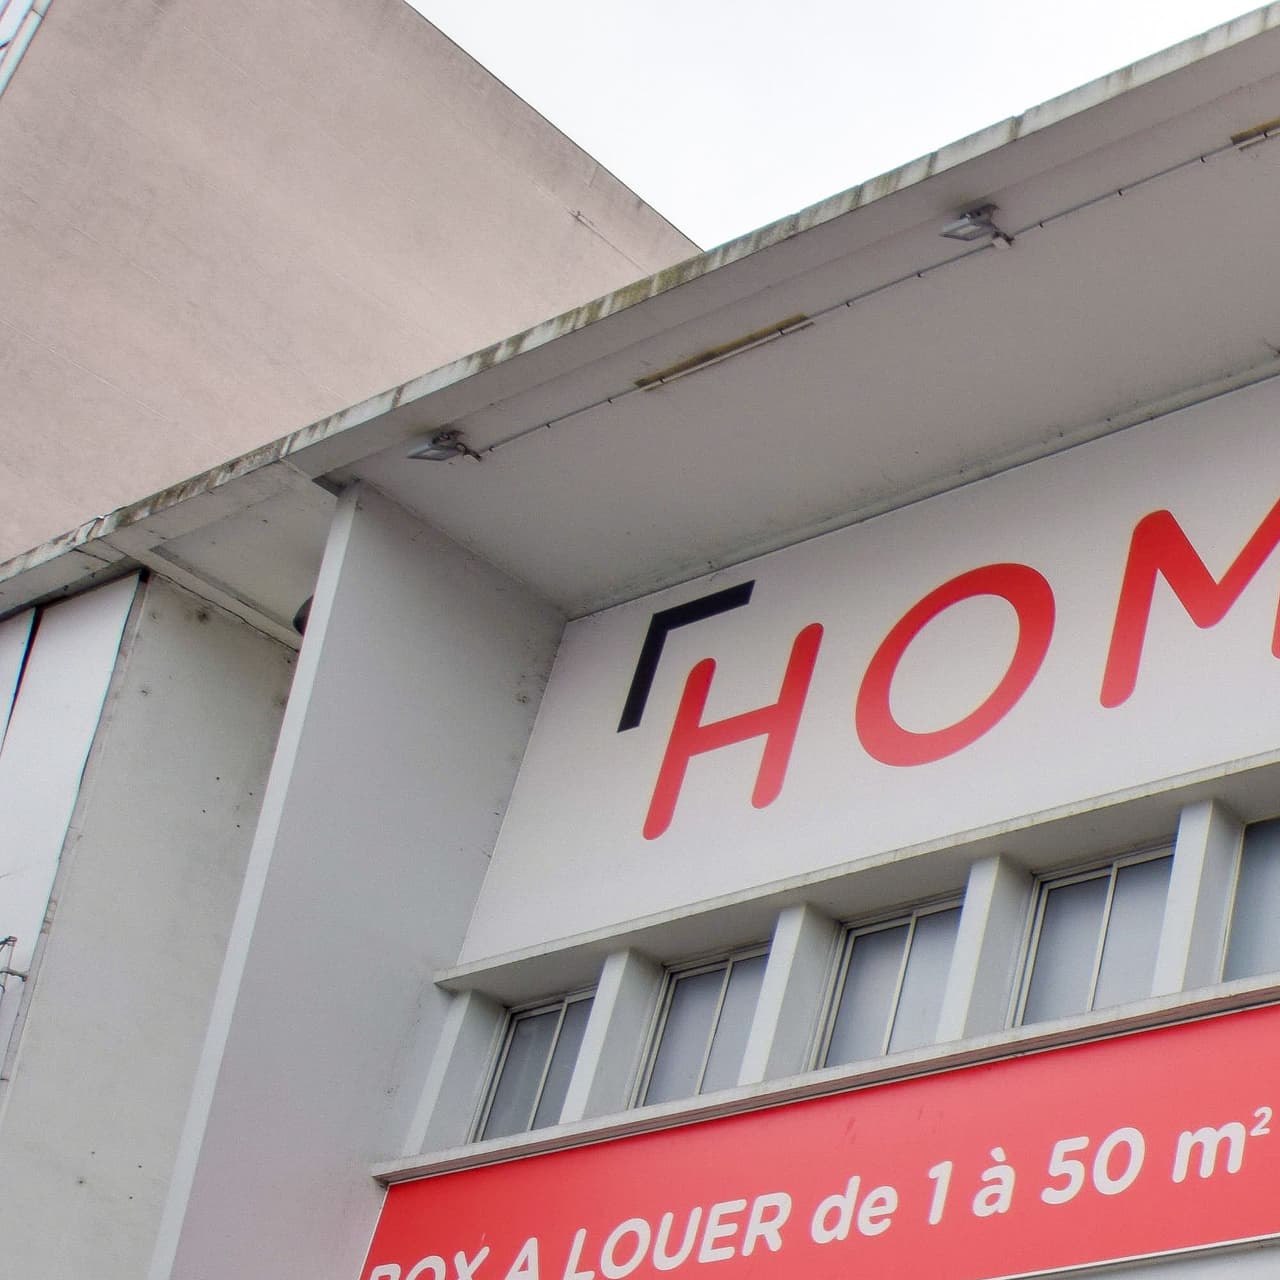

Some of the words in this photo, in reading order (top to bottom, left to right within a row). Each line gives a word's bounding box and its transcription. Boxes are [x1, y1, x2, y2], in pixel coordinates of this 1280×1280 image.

[810, 1174, 900, 1245] de
[927, 1159, 954, 1226] 1
[971, 1147, 1017, 1218] à
[1040, 1126, 1147, 1206] 50
